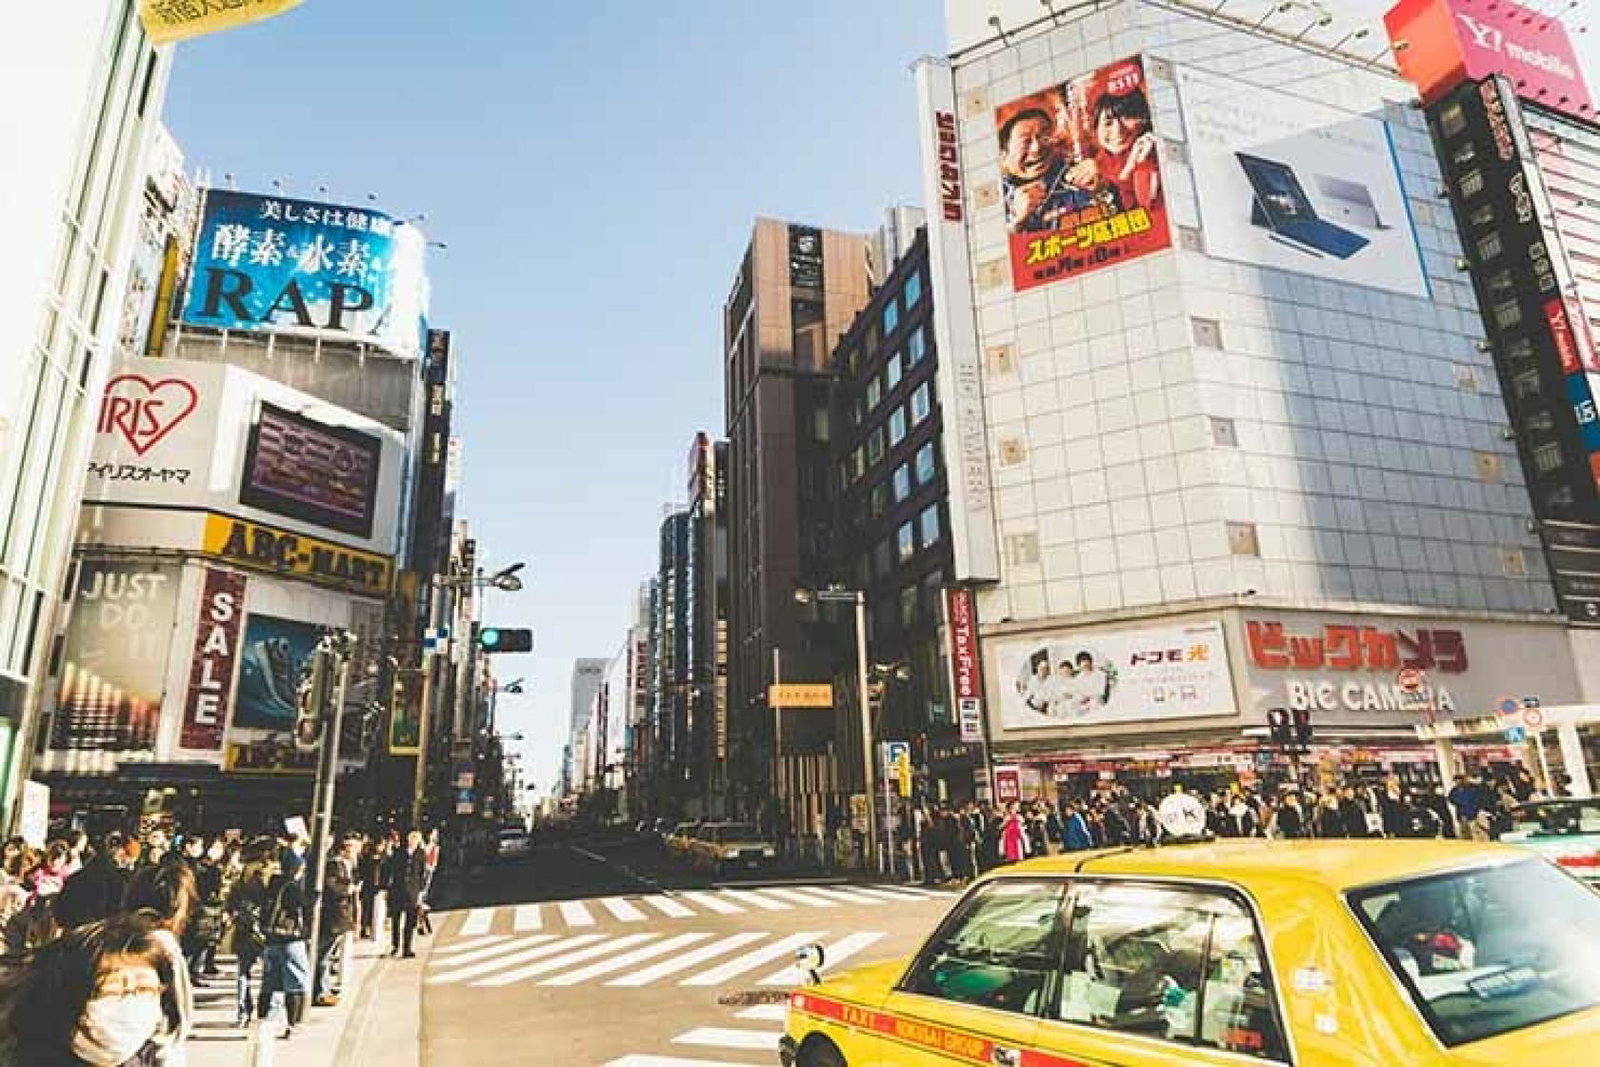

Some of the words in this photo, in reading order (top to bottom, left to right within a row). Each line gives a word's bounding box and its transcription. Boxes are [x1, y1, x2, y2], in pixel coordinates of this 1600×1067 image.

[97, 396, 164, 436] IRIS
[222, 520, 385, 589] ABC-MART
[80, 572, 168, 600] JUST
[101, 602, 150, 630] DO
[194, 592, 235, 724] SALE
[1246, 620, 1469, 675] ビックカメラ
[1286, 680, 1338, 711] BIC
[842, 1005, 875, 1029] TAXI
